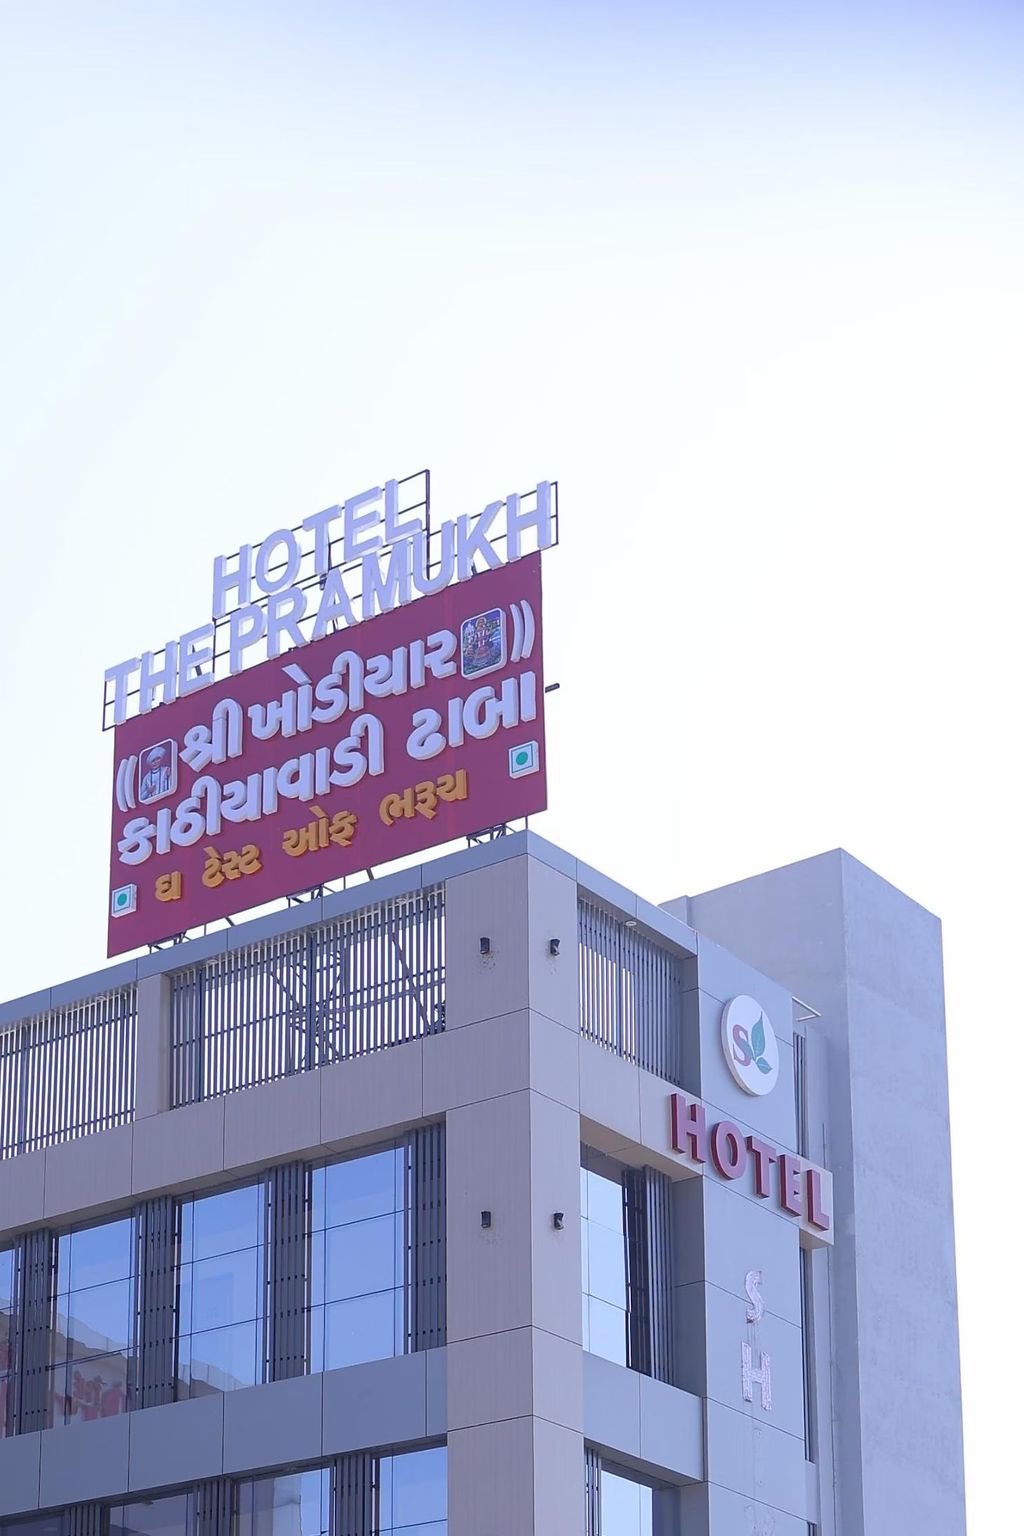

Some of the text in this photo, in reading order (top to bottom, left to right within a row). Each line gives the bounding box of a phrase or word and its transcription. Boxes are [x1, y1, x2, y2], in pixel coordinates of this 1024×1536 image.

[104, 480, 552, 725] THE PRAMUKH
[212, 478, 423, 619] HOTEL
[117, 671, 537, 865] કાઠીયાવાડી ઢાબા
[179, 629, 458, 772] શ્રી ખોડીયાર
[202, 844, 262, 888] ટેસ્ટ
[670, 1092, 830, 1231] HOTEL
